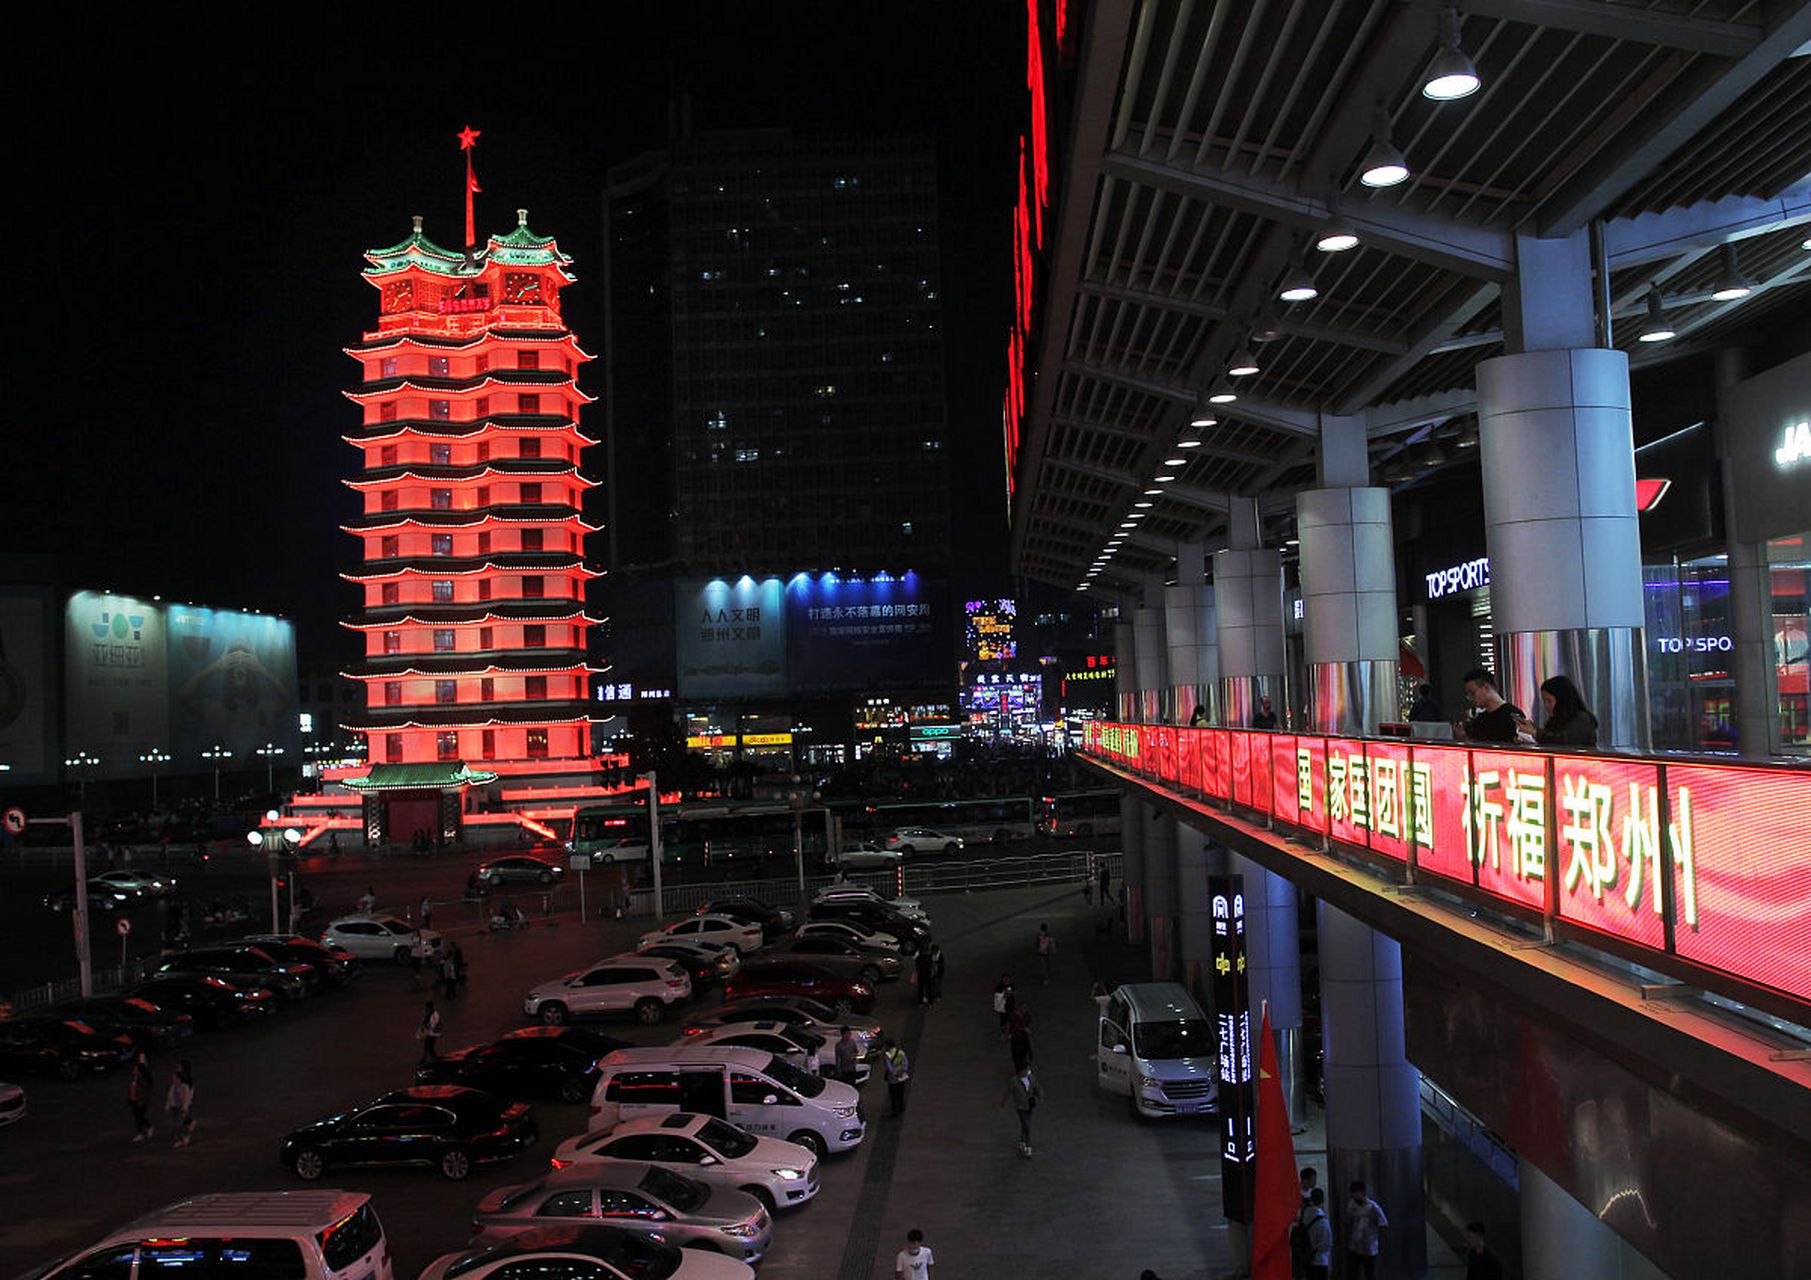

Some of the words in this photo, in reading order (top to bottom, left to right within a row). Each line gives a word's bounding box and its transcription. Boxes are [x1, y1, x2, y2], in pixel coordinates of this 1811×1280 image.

[700, 607, 761, 624] 人人文明
[1657, 636, 1734, 653] TOPSPO
[1329, 749, 1434, 850] 家国团圆
[1460, 767, 1698, 928] 祈福郑州
